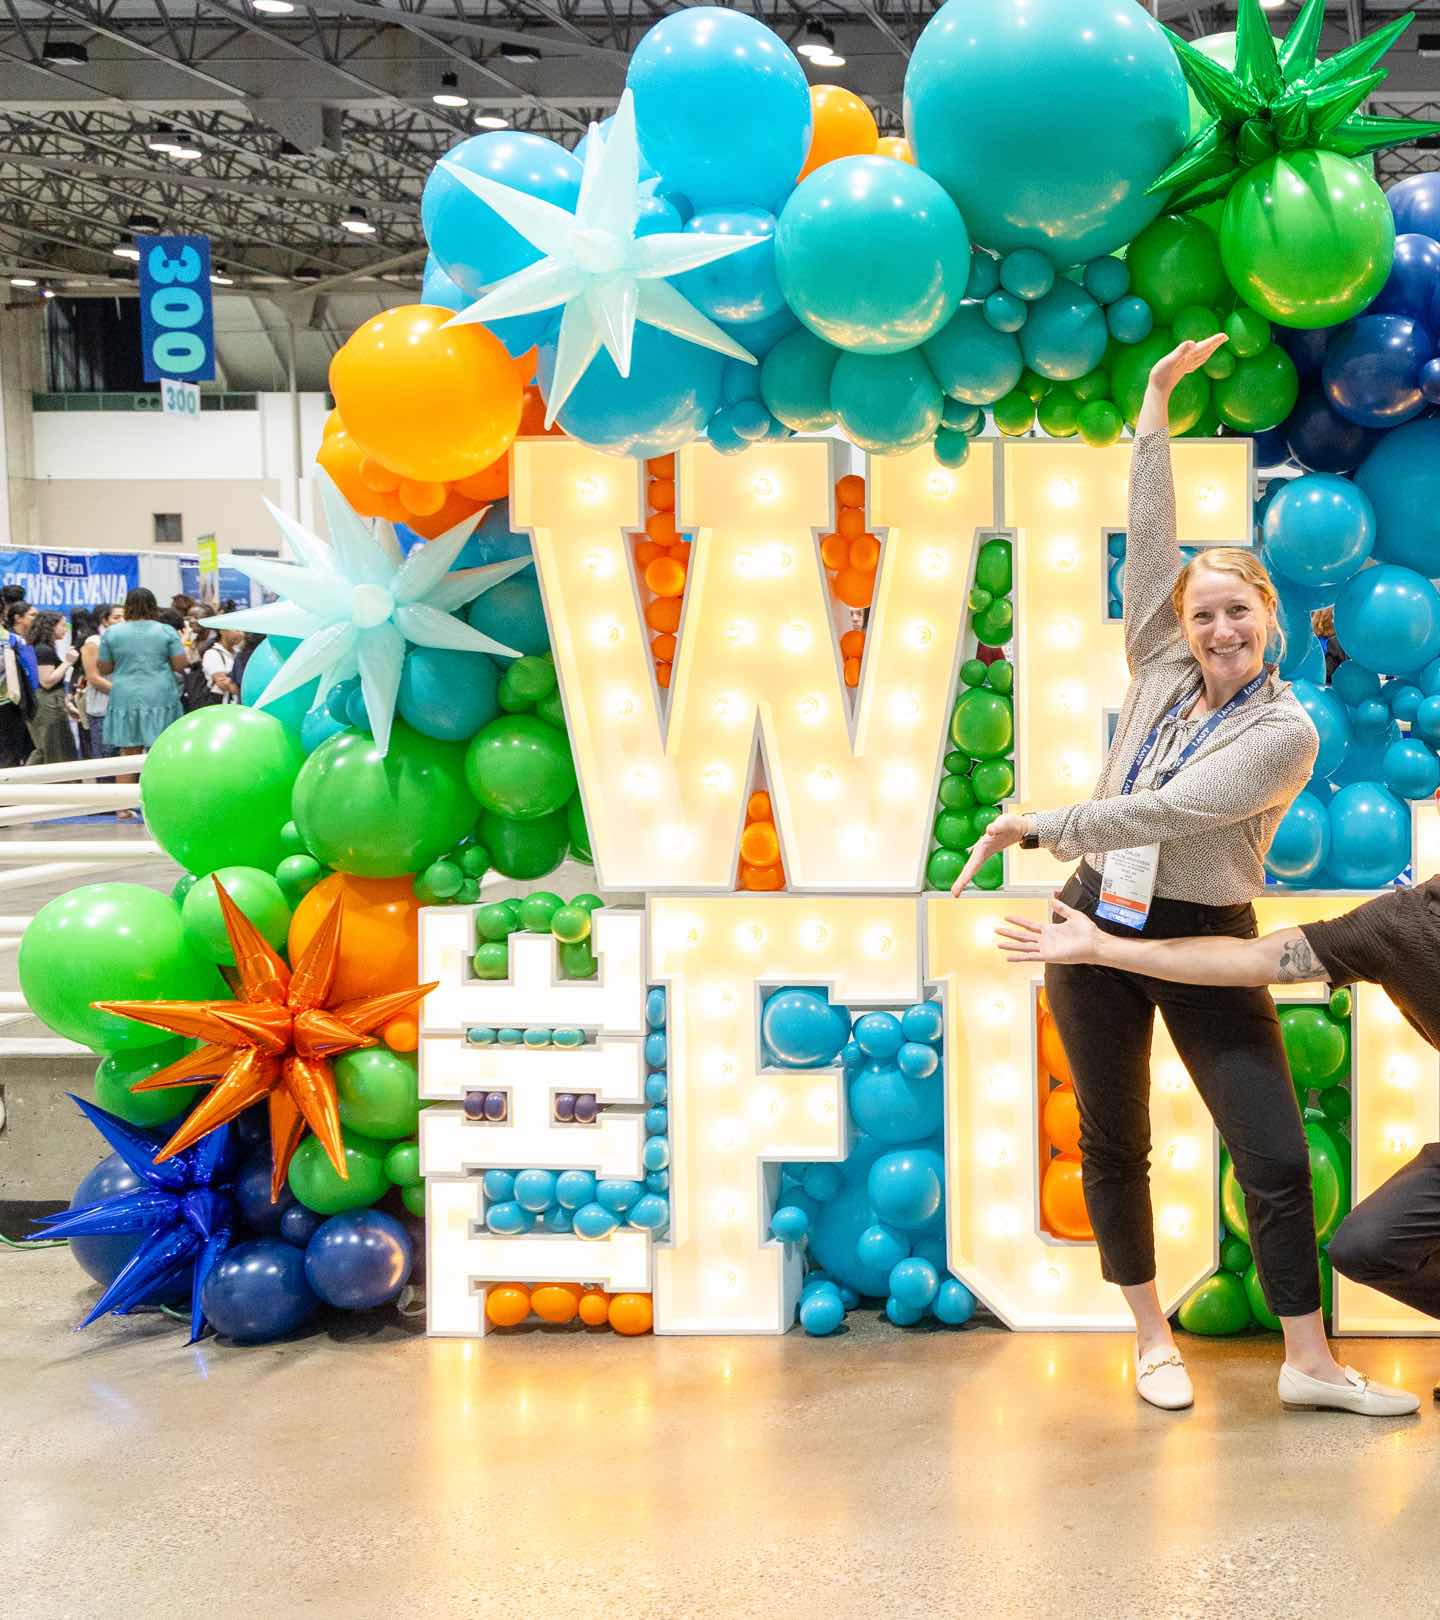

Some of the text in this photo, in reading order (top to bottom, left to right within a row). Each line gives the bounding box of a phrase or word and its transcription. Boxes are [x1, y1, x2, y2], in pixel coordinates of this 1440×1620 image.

[147, 244, 207, 374] 300
[166, 386, 197, 415] 300
[59, 556, 85, 576] Penn
[508, 436, 1256, 893] WE
[417, 904, 653, 1338] THE
